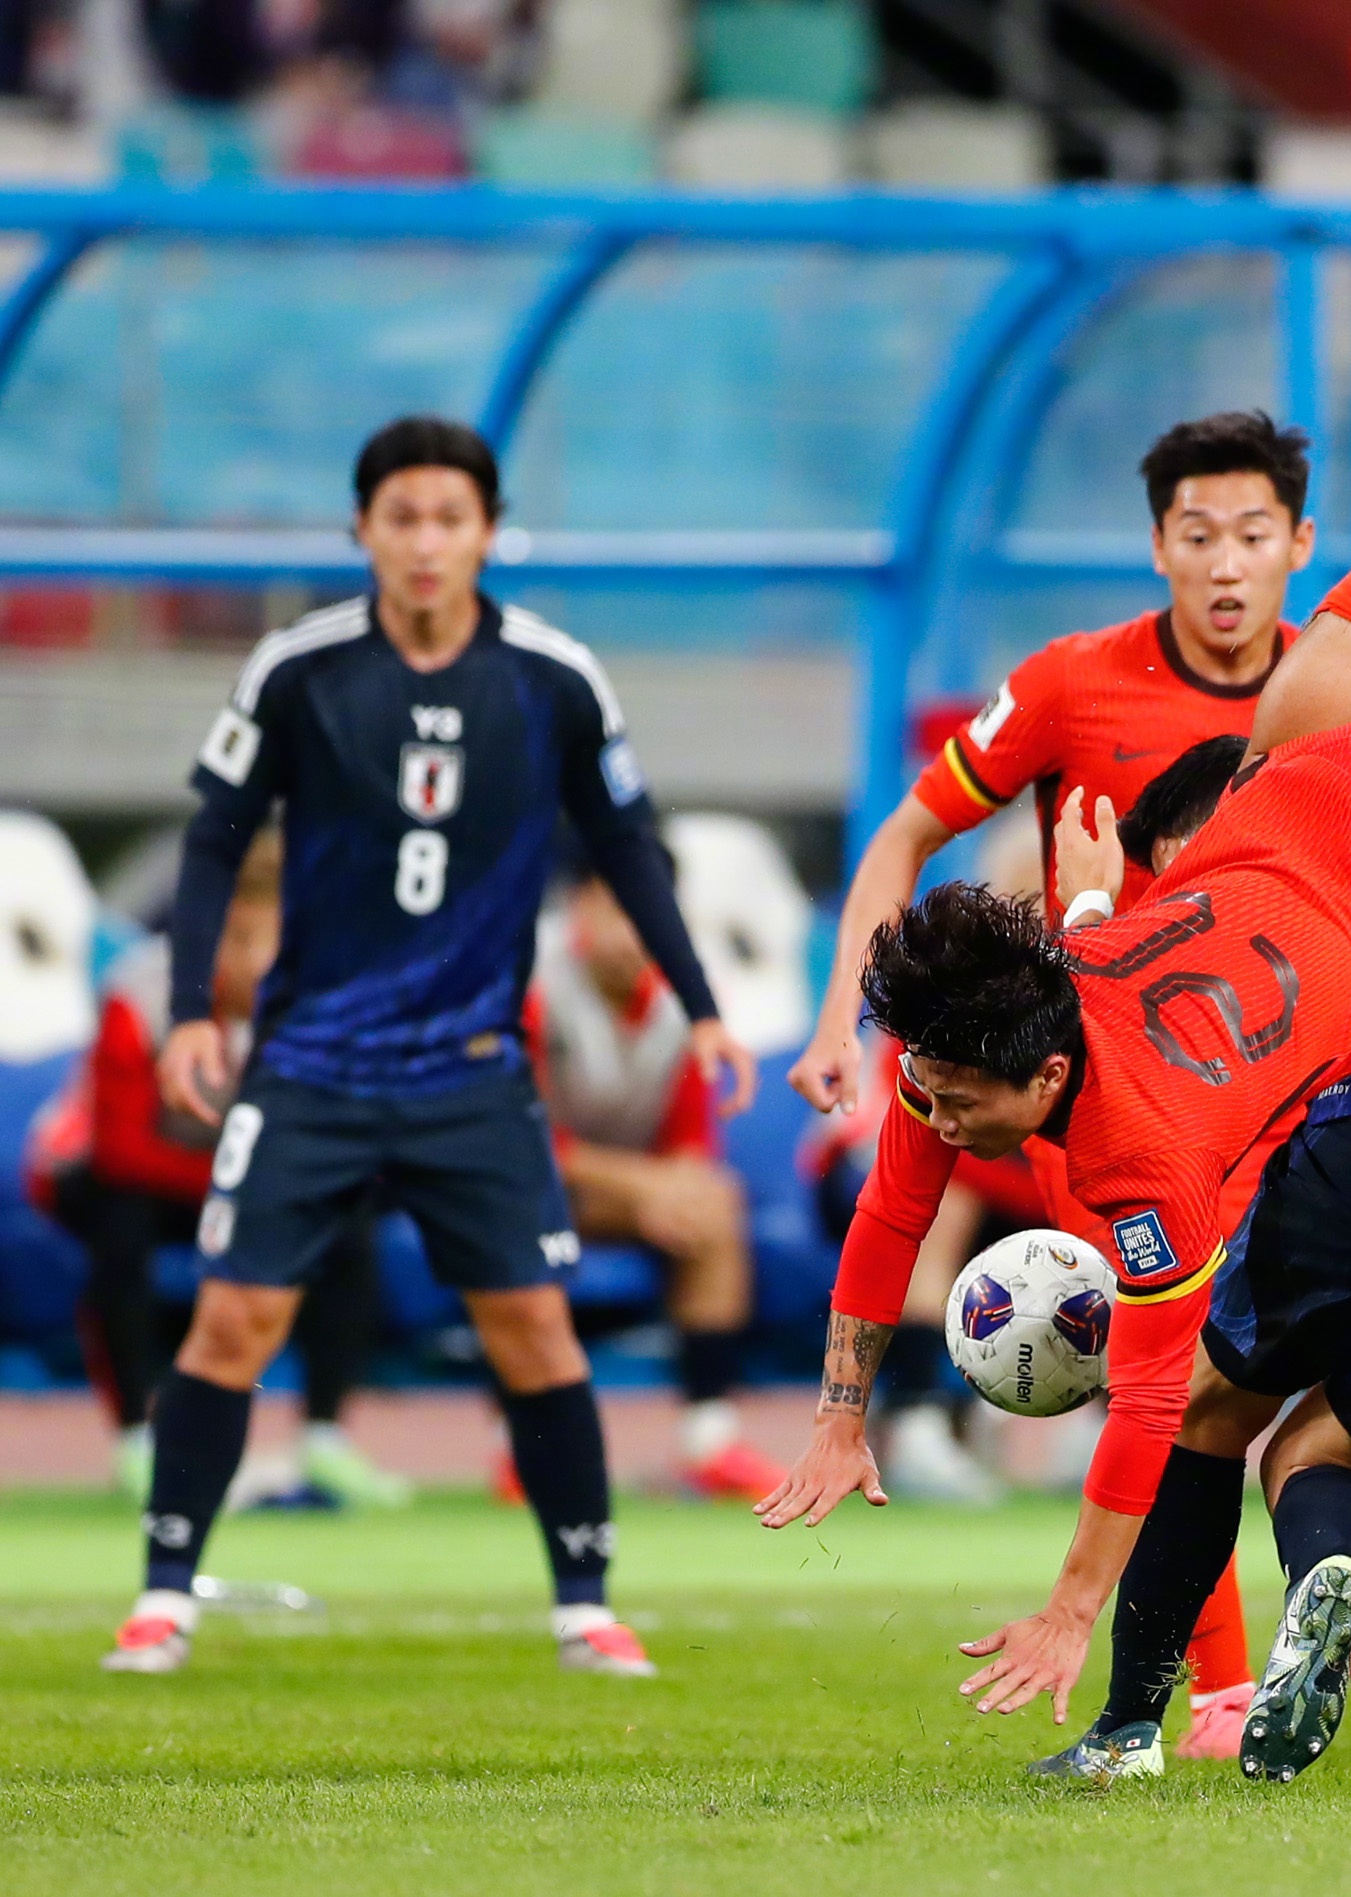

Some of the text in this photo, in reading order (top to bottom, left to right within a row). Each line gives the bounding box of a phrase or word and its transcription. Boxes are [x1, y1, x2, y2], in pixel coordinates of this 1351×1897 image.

[395, 829, 449, 915] 8
[211, 1103, 264, 1191] 8
[1121, 1222, 1150, 1239] FOOTBALL
[1123, 1232, 1155, 1251] UNITES
[1017, 1343, 1034, 1403] molten
